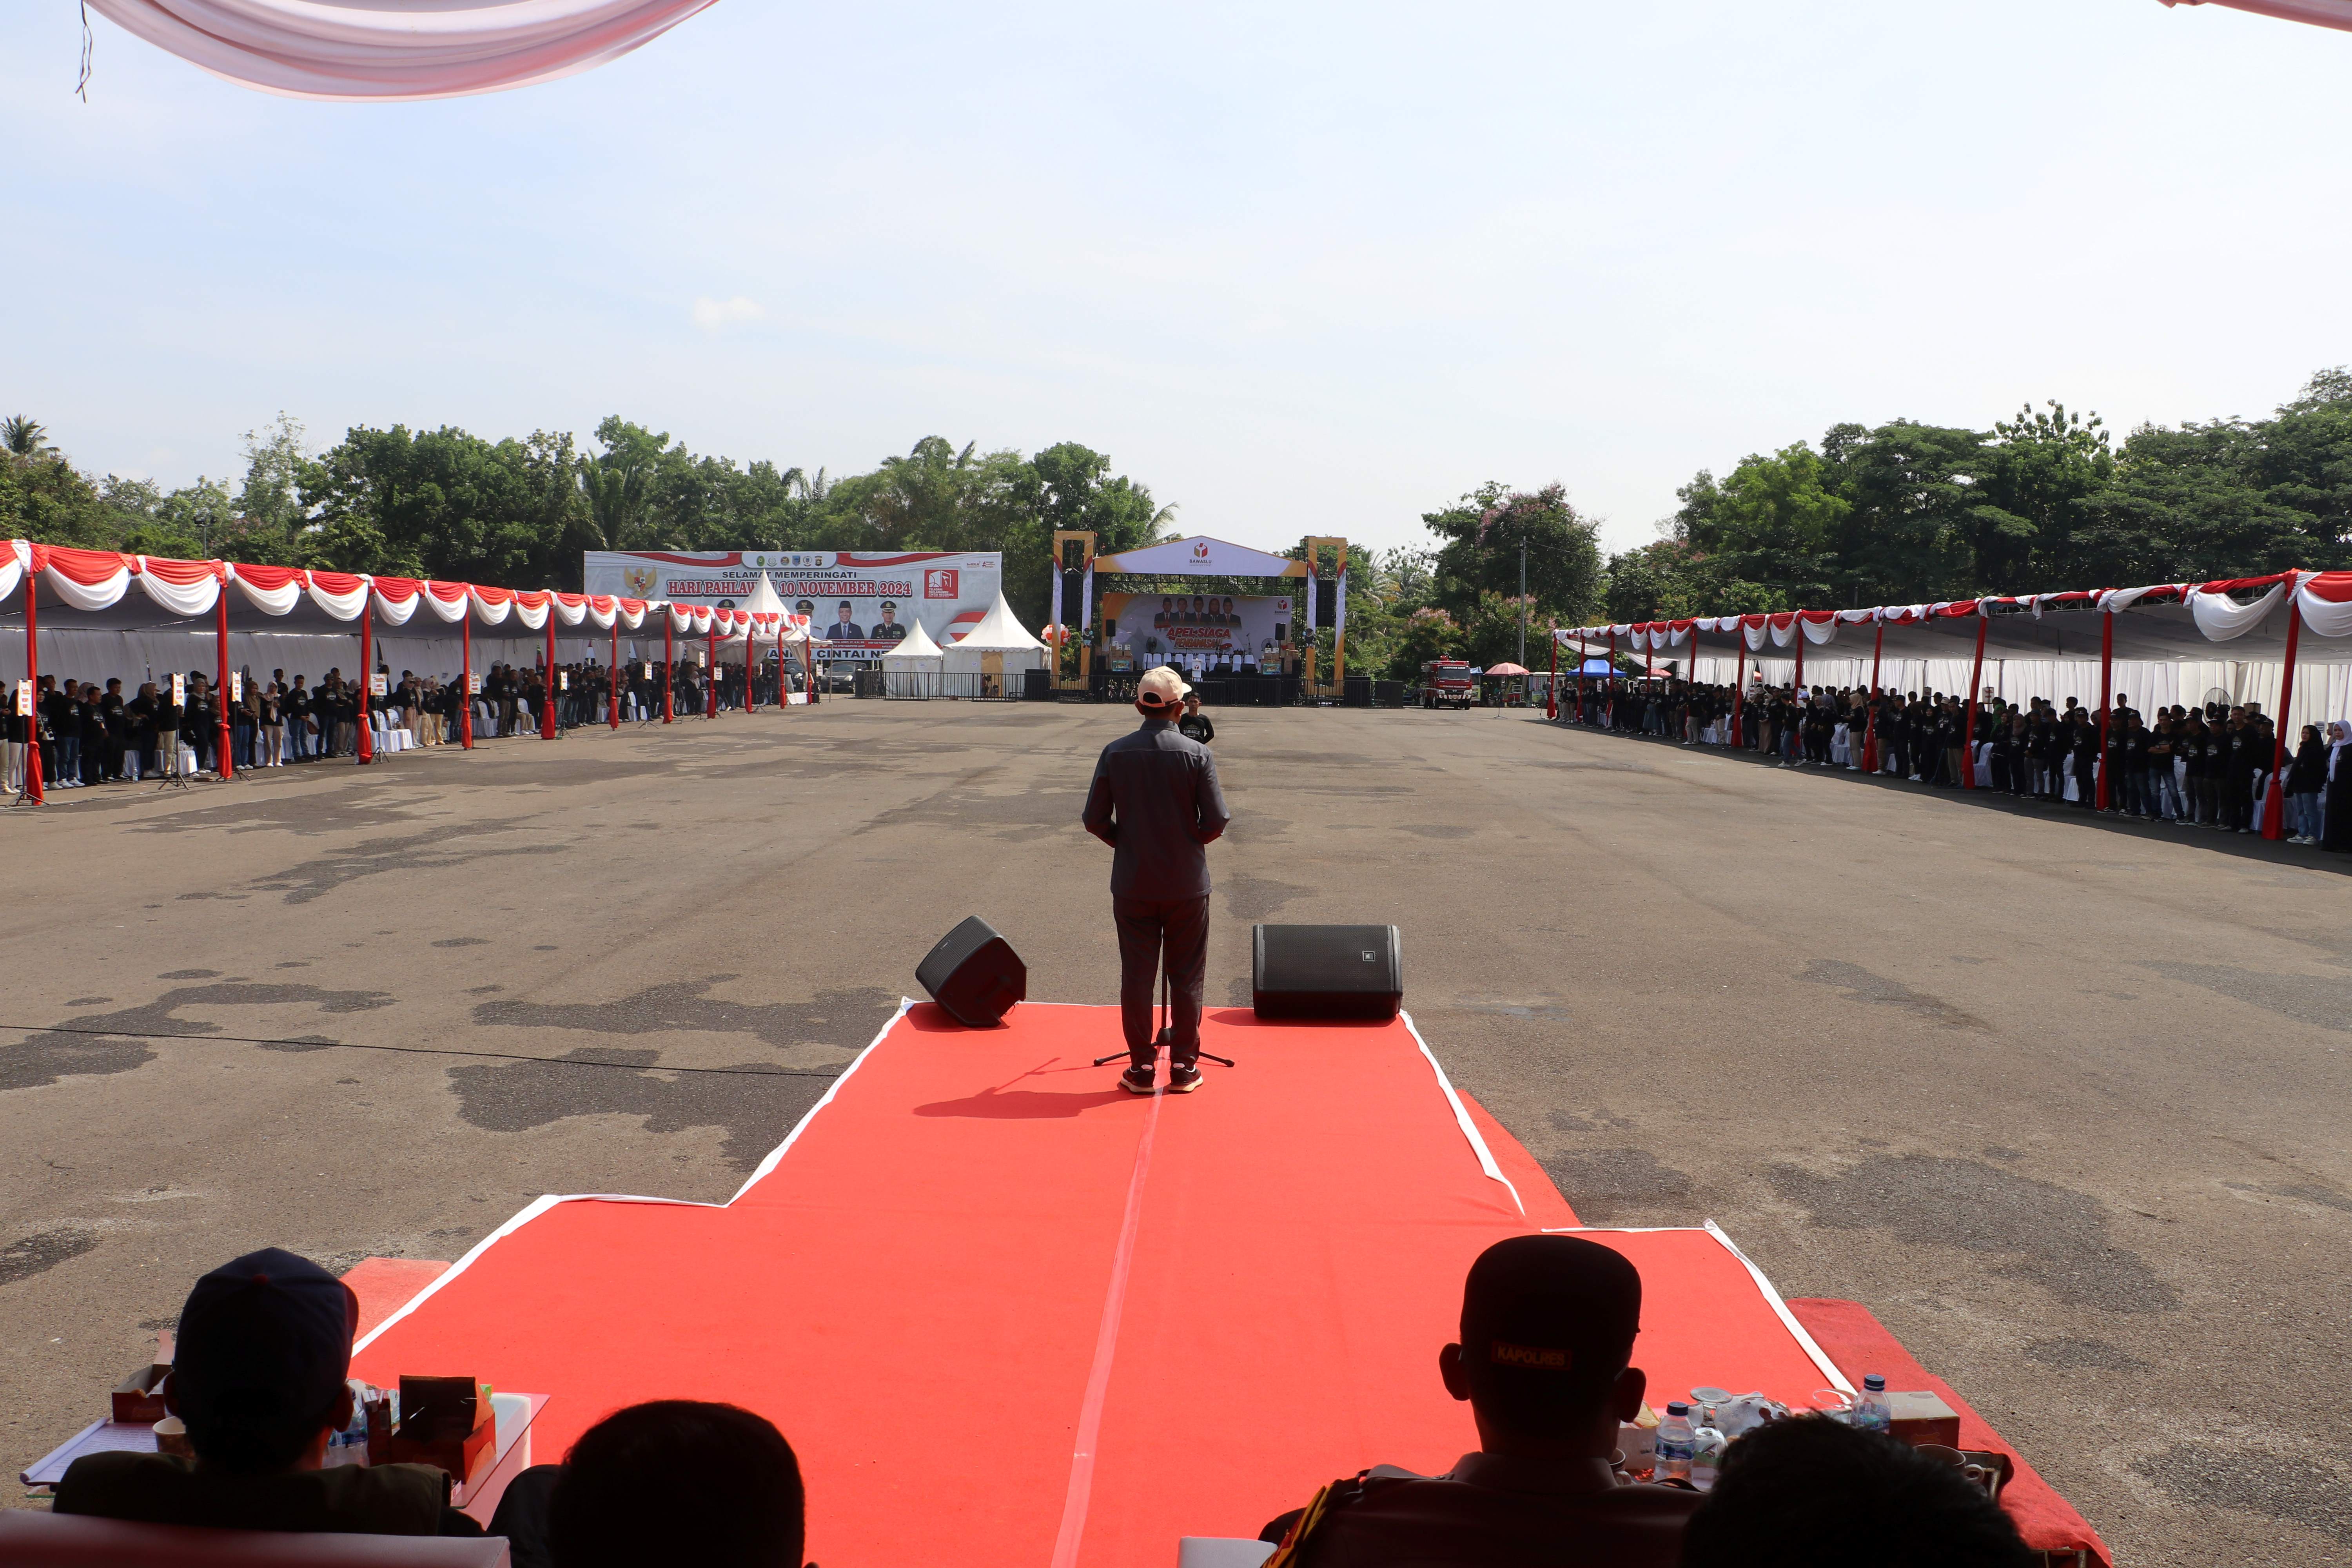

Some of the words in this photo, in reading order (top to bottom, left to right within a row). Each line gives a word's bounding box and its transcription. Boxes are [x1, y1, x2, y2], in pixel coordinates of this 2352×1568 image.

[667, 581, 702, 595] HARI
[704, 581, 776, 595] PAHLAW
[780, 581, 796, 595] 10
[799, 581, 877, 595] NOVEMBER
[880, 582, 912, 595] 2024
[1167, 627, 1196, 637] APEL
[1197, 628, 1231, 638] SIAGA
[1497, 1345, 1565, 1366] KAPOLRES
